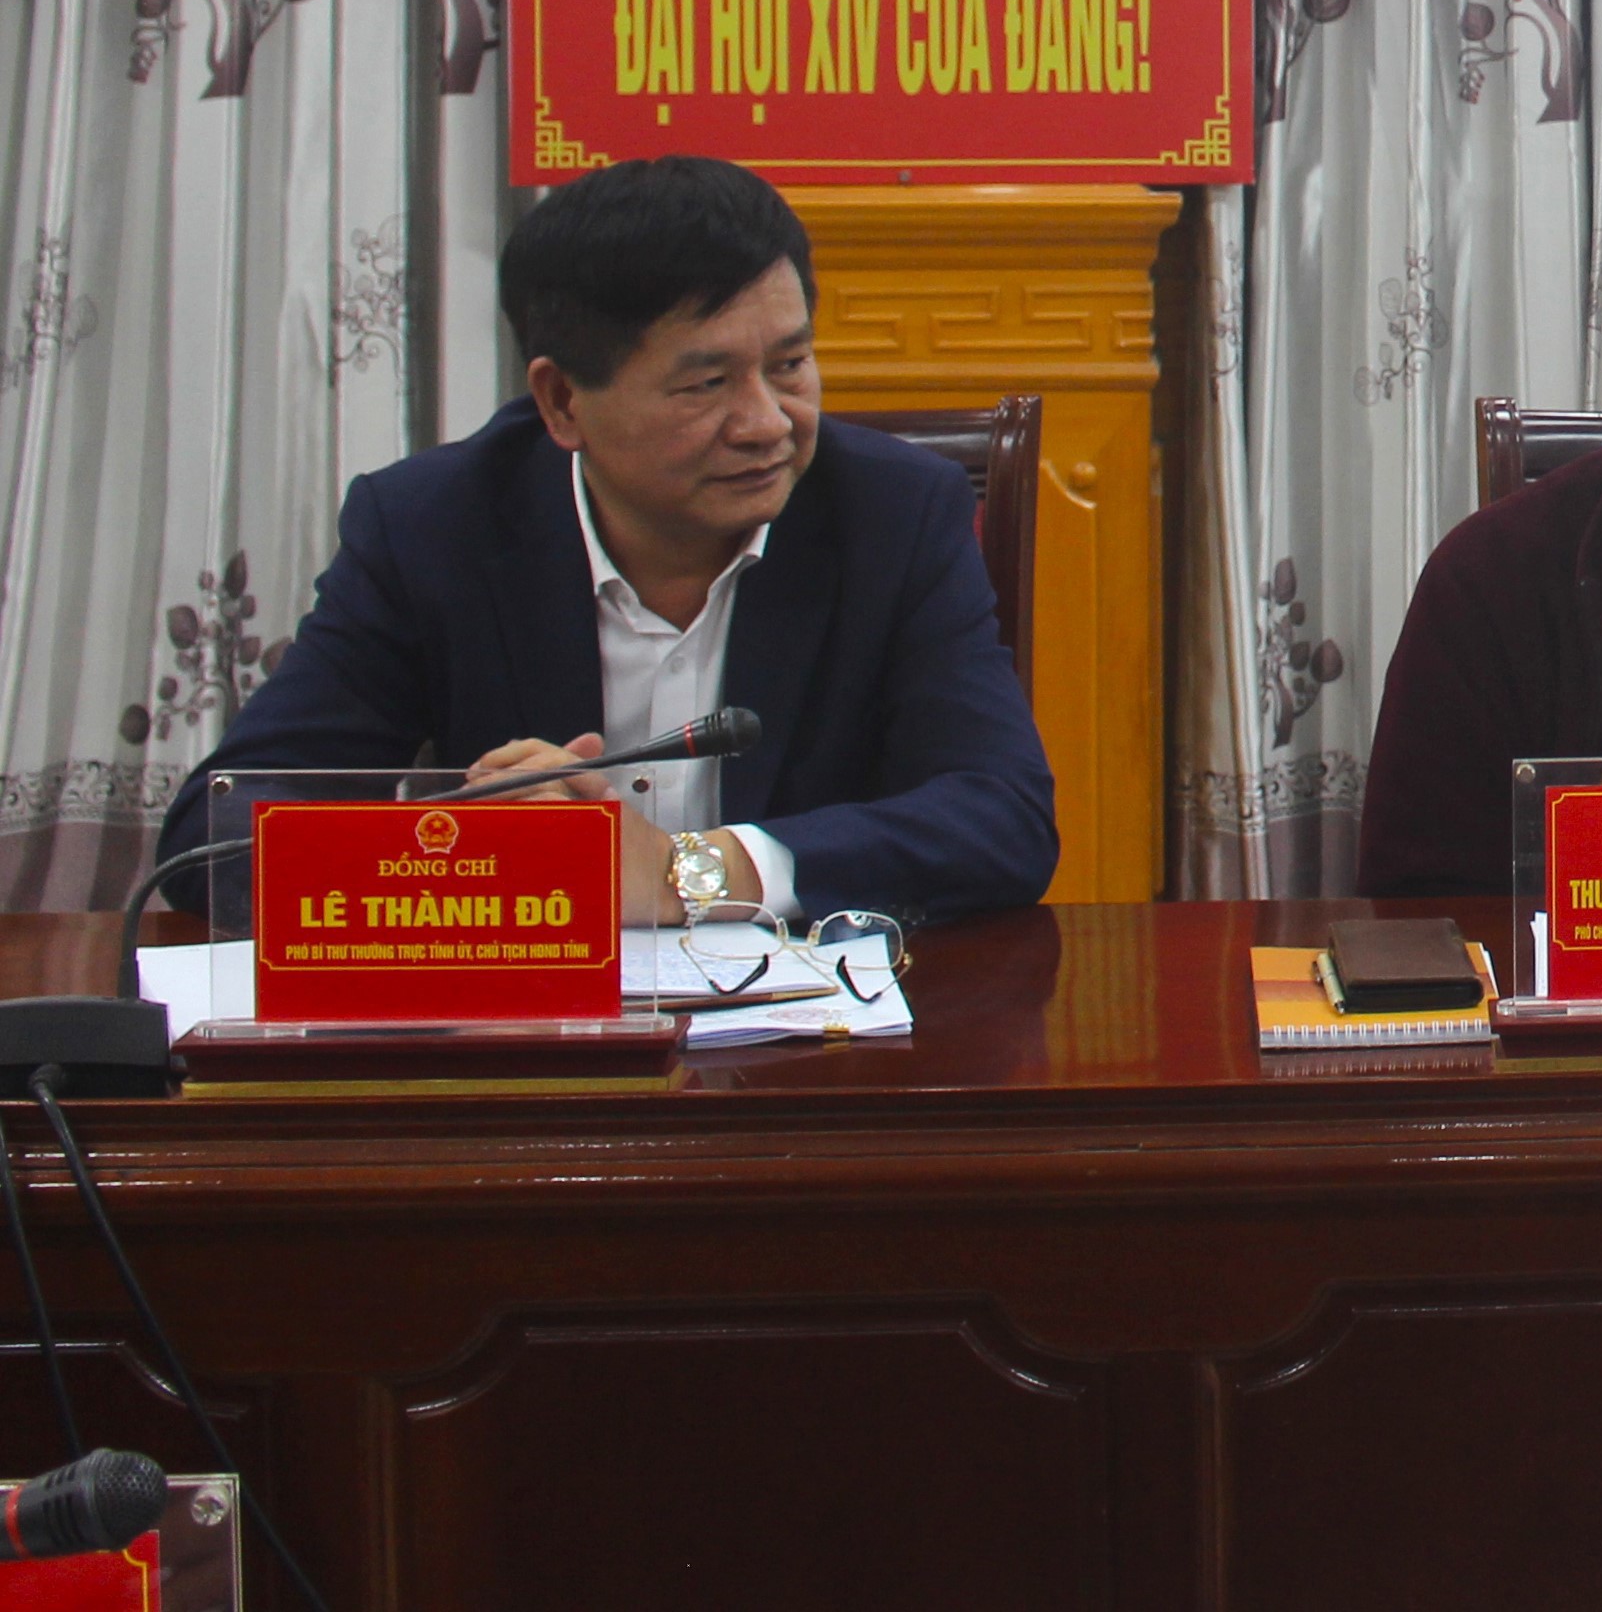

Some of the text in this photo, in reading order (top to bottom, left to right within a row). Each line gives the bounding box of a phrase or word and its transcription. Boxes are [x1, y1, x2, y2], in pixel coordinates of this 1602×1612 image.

[378, 852, 497, 877] ĐỒNG CHÍ
[300, 889, 572, 928] LÊ THÀNH ĐÔ
